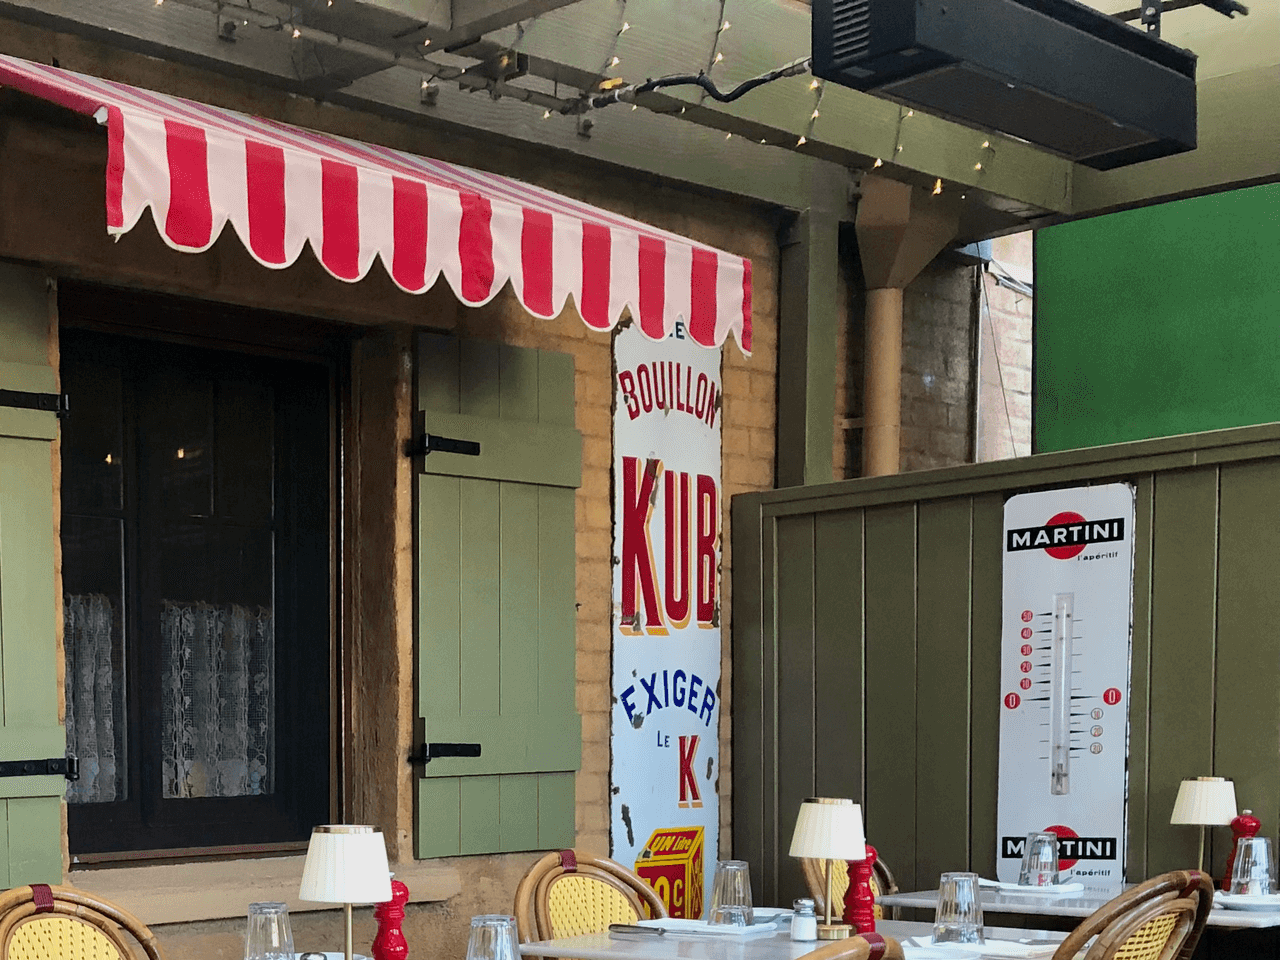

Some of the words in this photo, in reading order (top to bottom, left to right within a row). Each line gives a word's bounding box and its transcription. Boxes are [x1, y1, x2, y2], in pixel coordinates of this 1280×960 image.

[669, 321, 685, 340] E
[618, 361, 716, 429] BOUILLON
[619, 456, 720, 636] KUB
[1012, 522, 1118, 548] MARTINI
[620, 669, 716, 728] EXIGER
[678, 735, 704, 808] K
[650, 835, 677, 852] UN
[1007, 840, 1110, 856] MTINI
